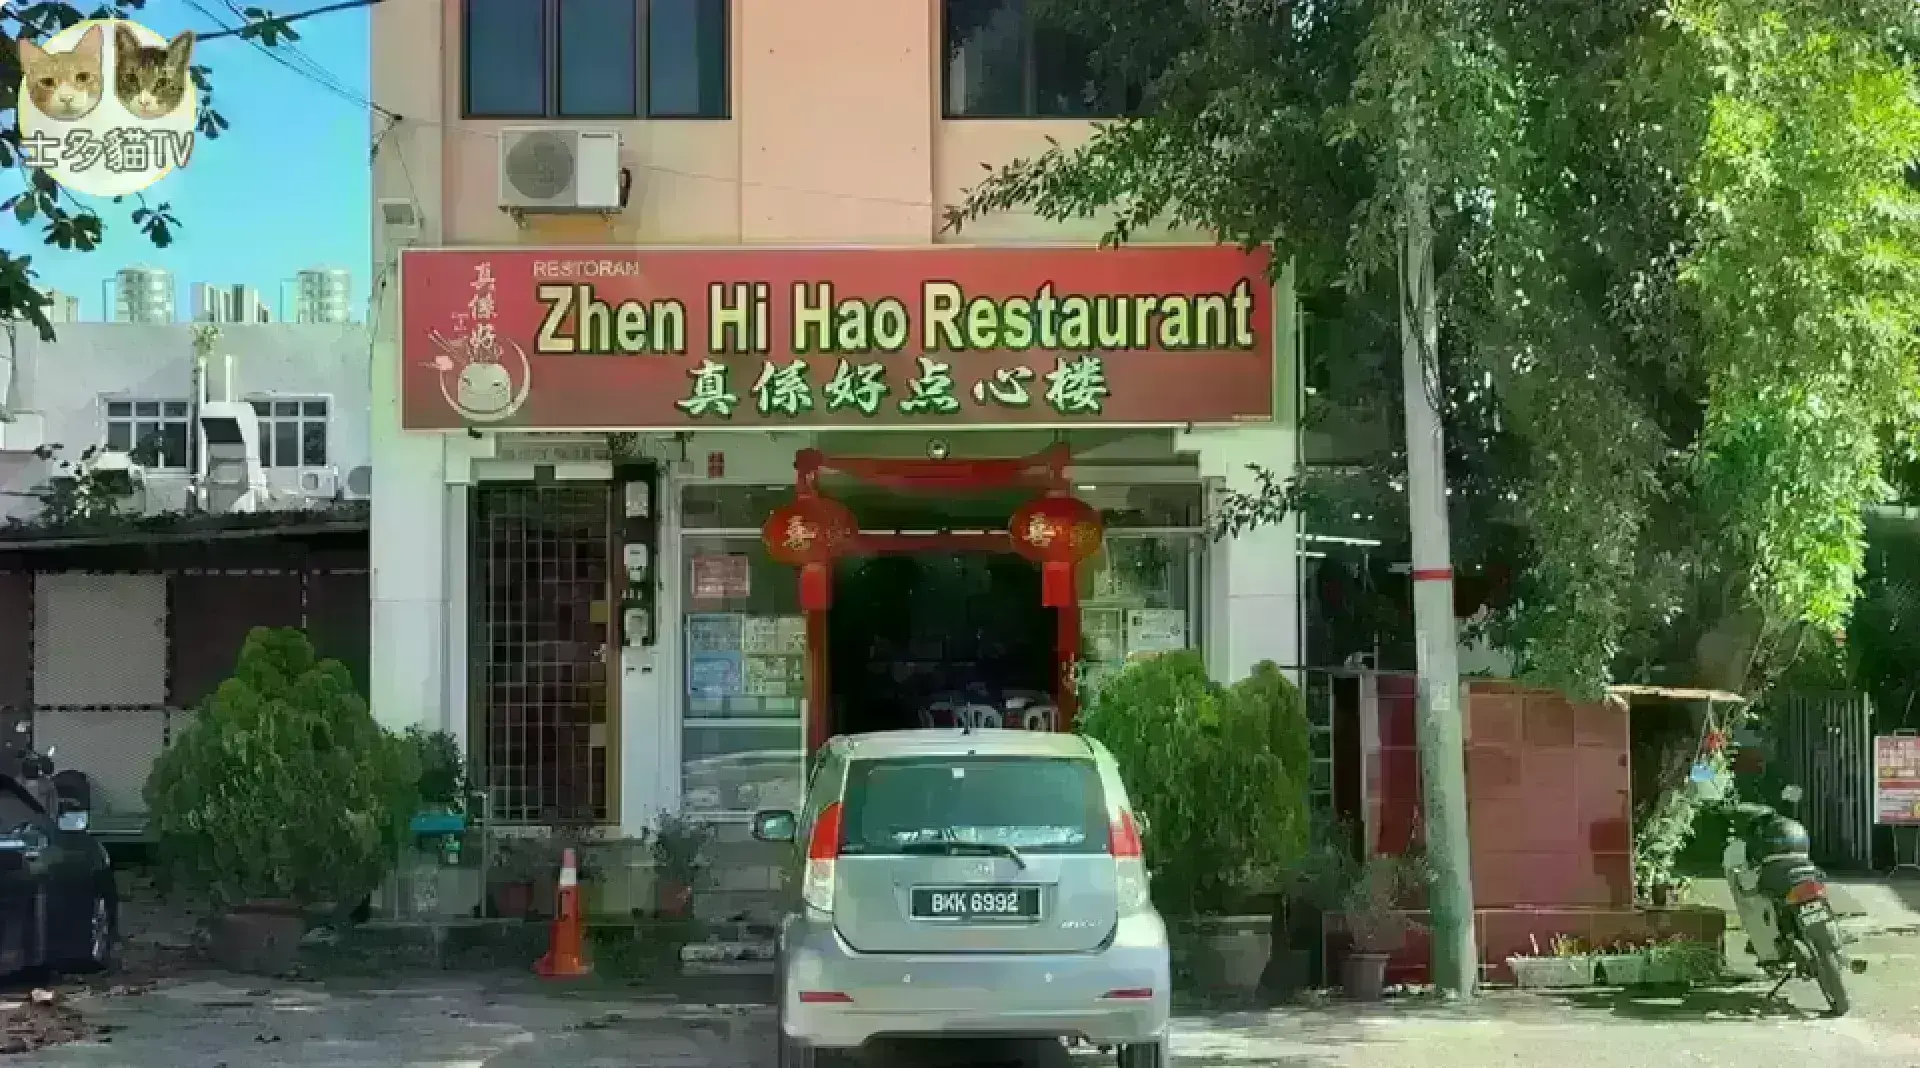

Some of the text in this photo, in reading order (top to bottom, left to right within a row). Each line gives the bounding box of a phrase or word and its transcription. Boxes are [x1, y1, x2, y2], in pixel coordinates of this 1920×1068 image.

[533, 260, 639, 277] RESTORAN
[534, 278, 1255, 355] Zhen Hi Hao Restaurant
[676, 355, 1111, 418] 真係好点心楼
[931, 891, 1020, 913] BKK 6992
